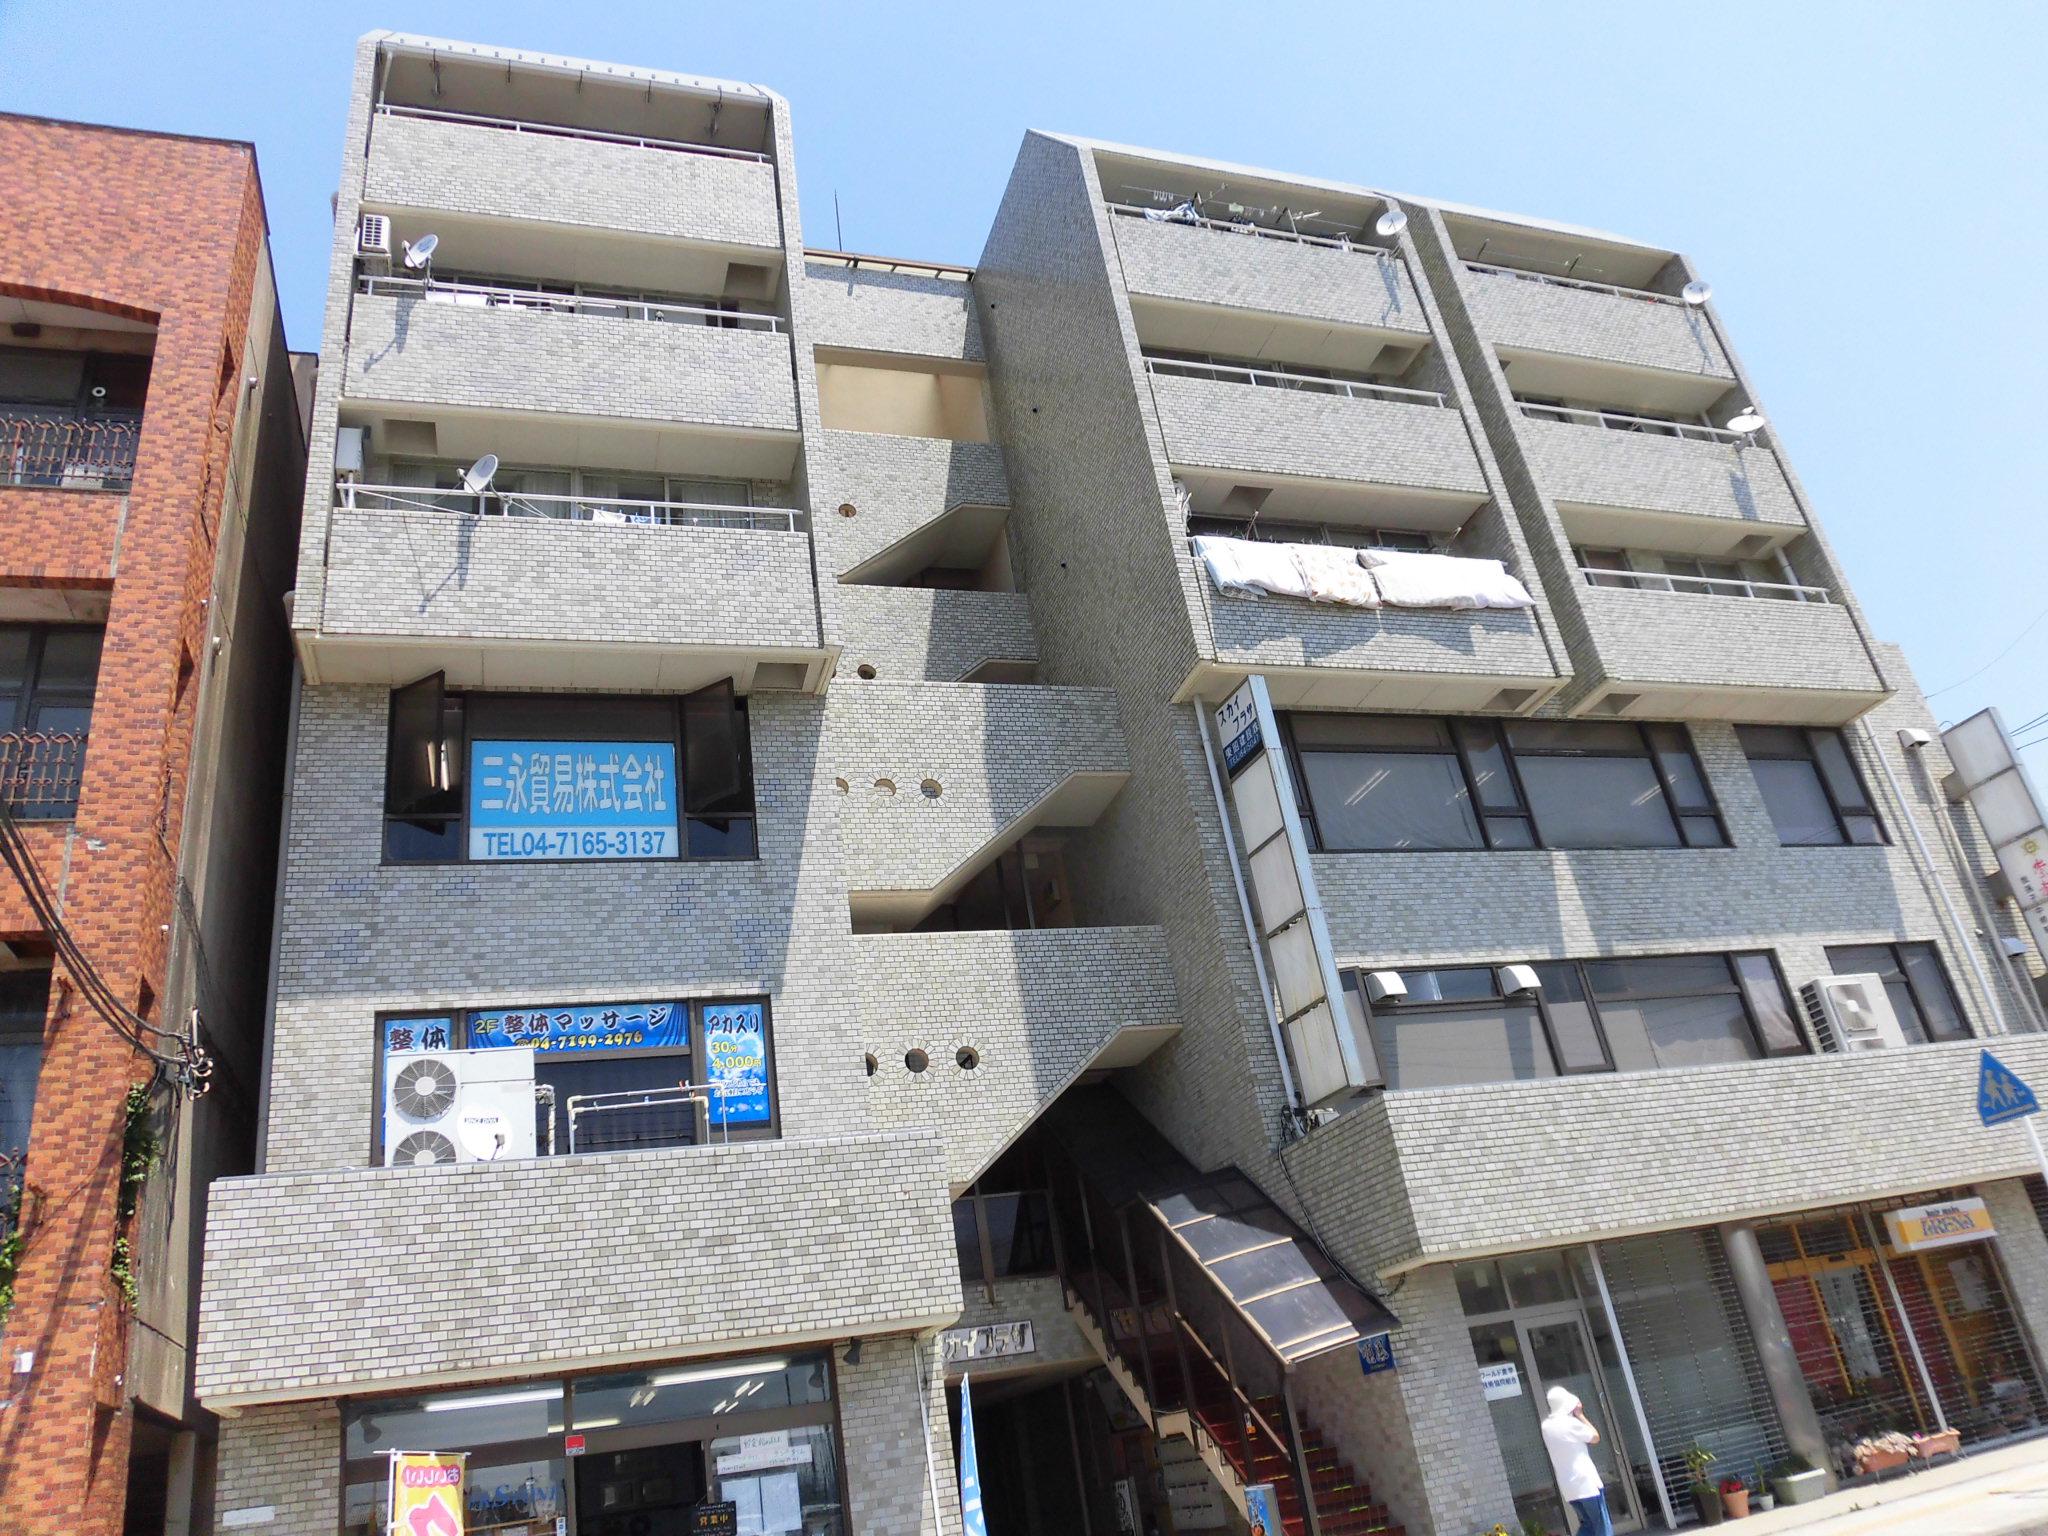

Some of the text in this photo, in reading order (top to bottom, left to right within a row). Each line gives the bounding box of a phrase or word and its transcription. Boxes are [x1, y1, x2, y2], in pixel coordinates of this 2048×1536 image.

[1218, 694, 1239, 727] スカイ
[1232, 702, 1253, 733] プラザ
[481, 751, 667, 815] 三永貿易株式会社
[483, 831, 666, 857] TEL04-7165-3137
[474, 1007, 668, 1036] 2F 整体マッサージ
[708, 1013, 760, 1035] アカスリ
[387, 1026, 447, 1053] 整体
